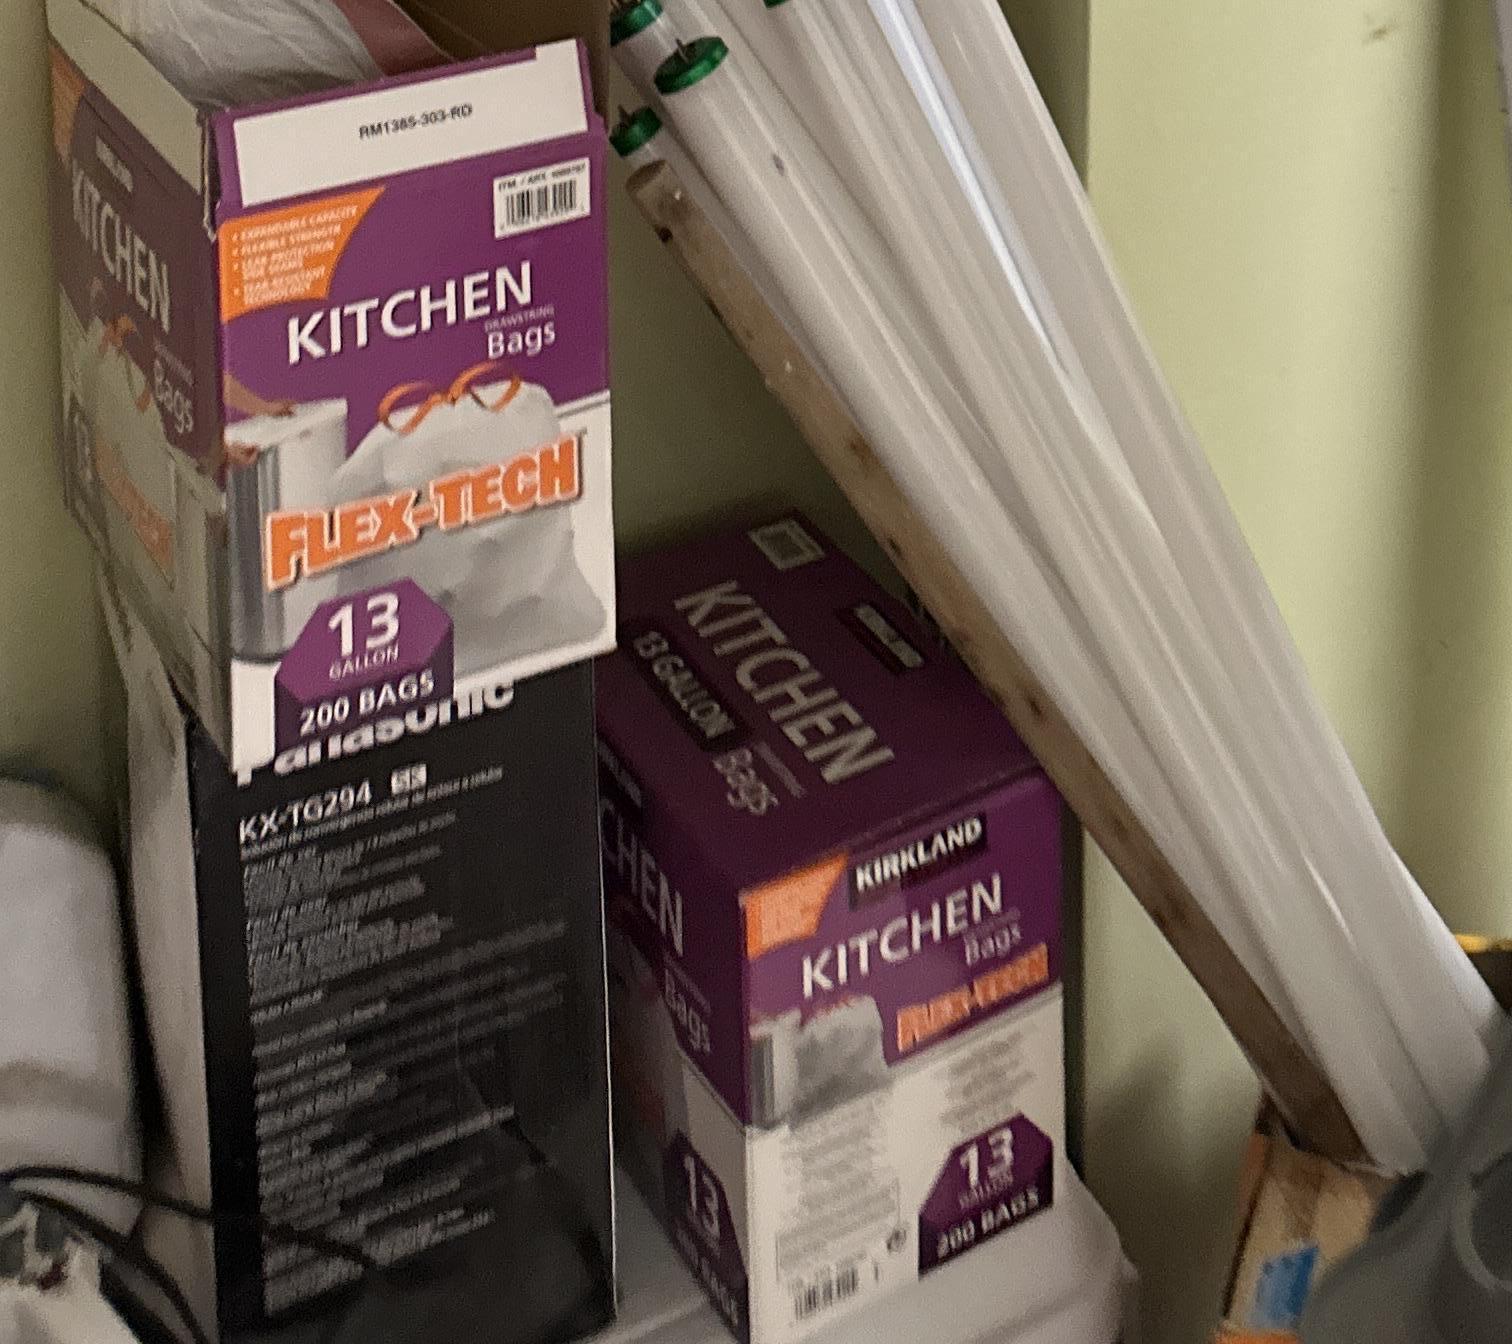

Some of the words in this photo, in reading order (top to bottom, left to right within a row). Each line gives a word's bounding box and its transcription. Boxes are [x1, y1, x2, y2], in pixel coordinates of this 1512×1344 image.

[71, 158, 171, 335] KITCHEN
[287, 259, 533, 366] KITCHEN
[487, 320, 556, 360] Bags
[263, 431, 584, 592] FLEX-TECH
[327, 591, 401, 658] 13
[328, 642, 400, 681] GALLON
[299, 696, 351, 737] 200
[358, 668, 436, 715] BAGS
[673, 578, 897, 785] KITCHEN
[713, 747, 780, 815] Bags
[855, 814, 984, 894] KIRKLAND
[802, 871, 1003, 1002] KITCHEN
[958, 1126, 1014, 1189] 13
